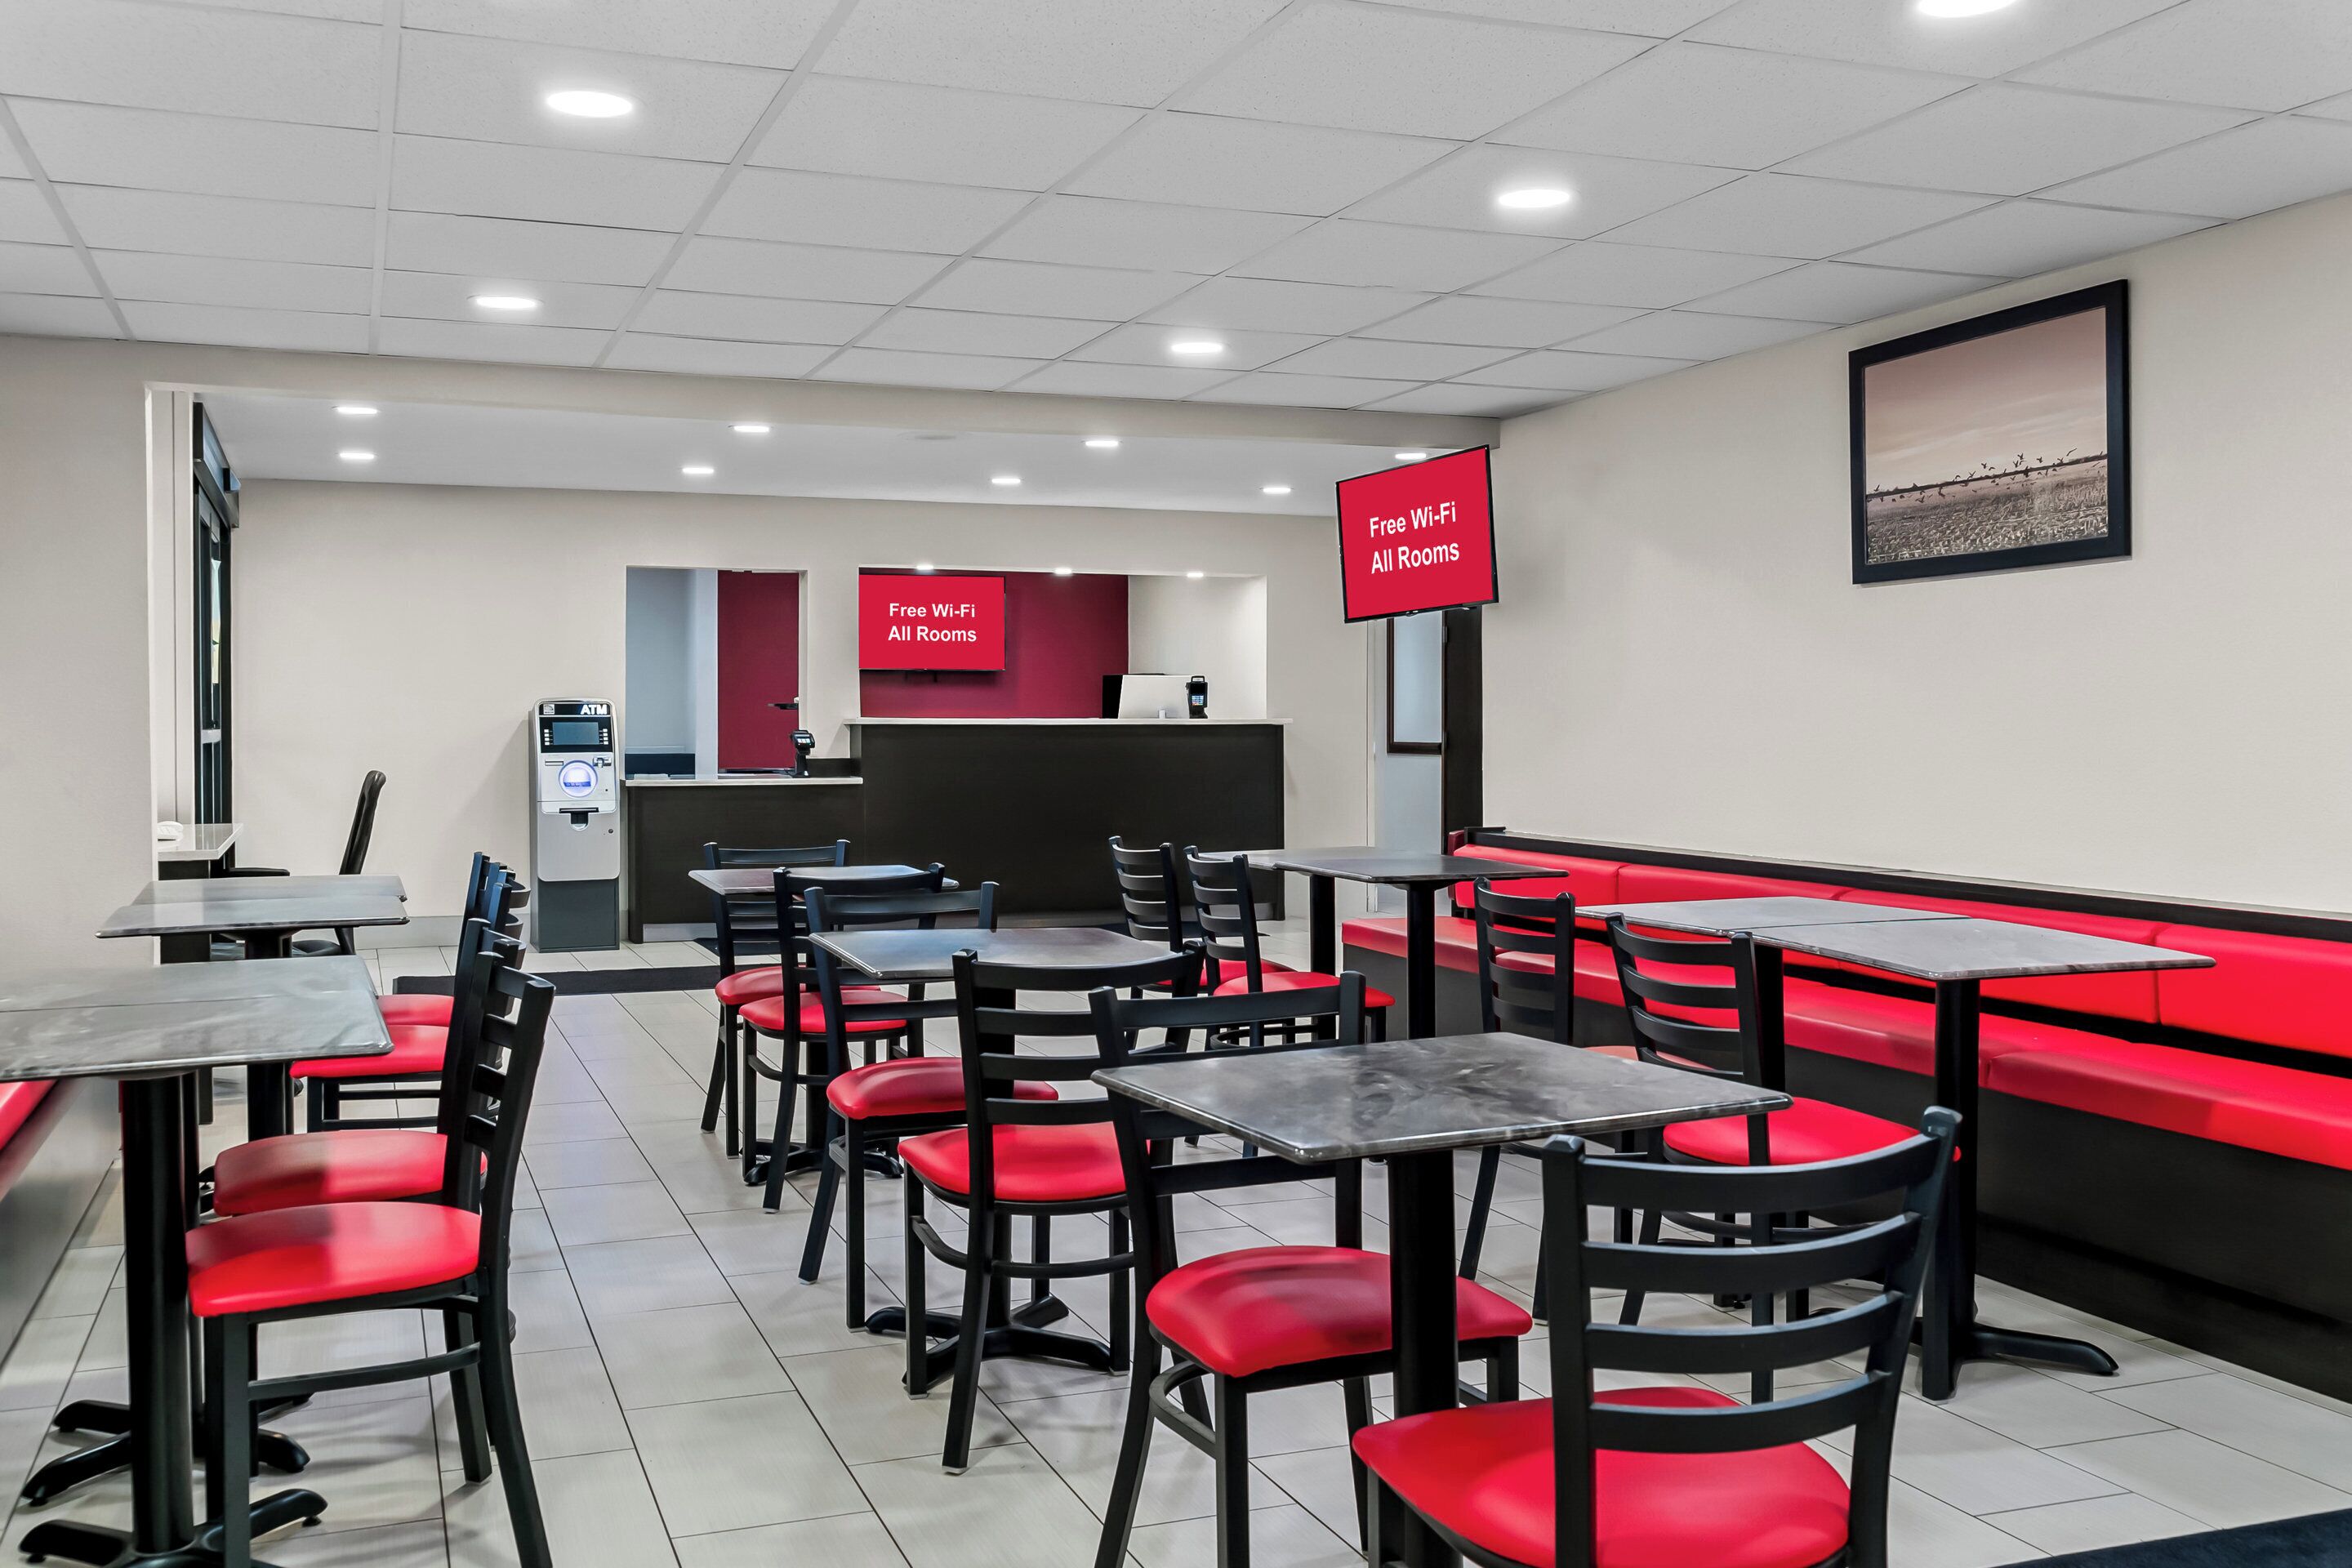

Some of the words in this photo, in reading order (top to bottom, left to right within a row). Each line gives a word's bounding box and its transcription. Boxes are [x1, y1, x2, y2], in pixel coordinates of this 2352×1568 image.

[1370, 516, 1406, 538] Free
[1410, 501, 1456, 530] Wi-Fi
[1371, 549, 1393, 574] All
[1397, 542, 1460, 570] Rooms
[889, 603, 927, 617] Free
[931, 603, 975, 618] Wi-Fi
[888, 625, 911, 641] All
[916, 626, 978, 643] Rooms
[581, 704, 608, 715] ATM
